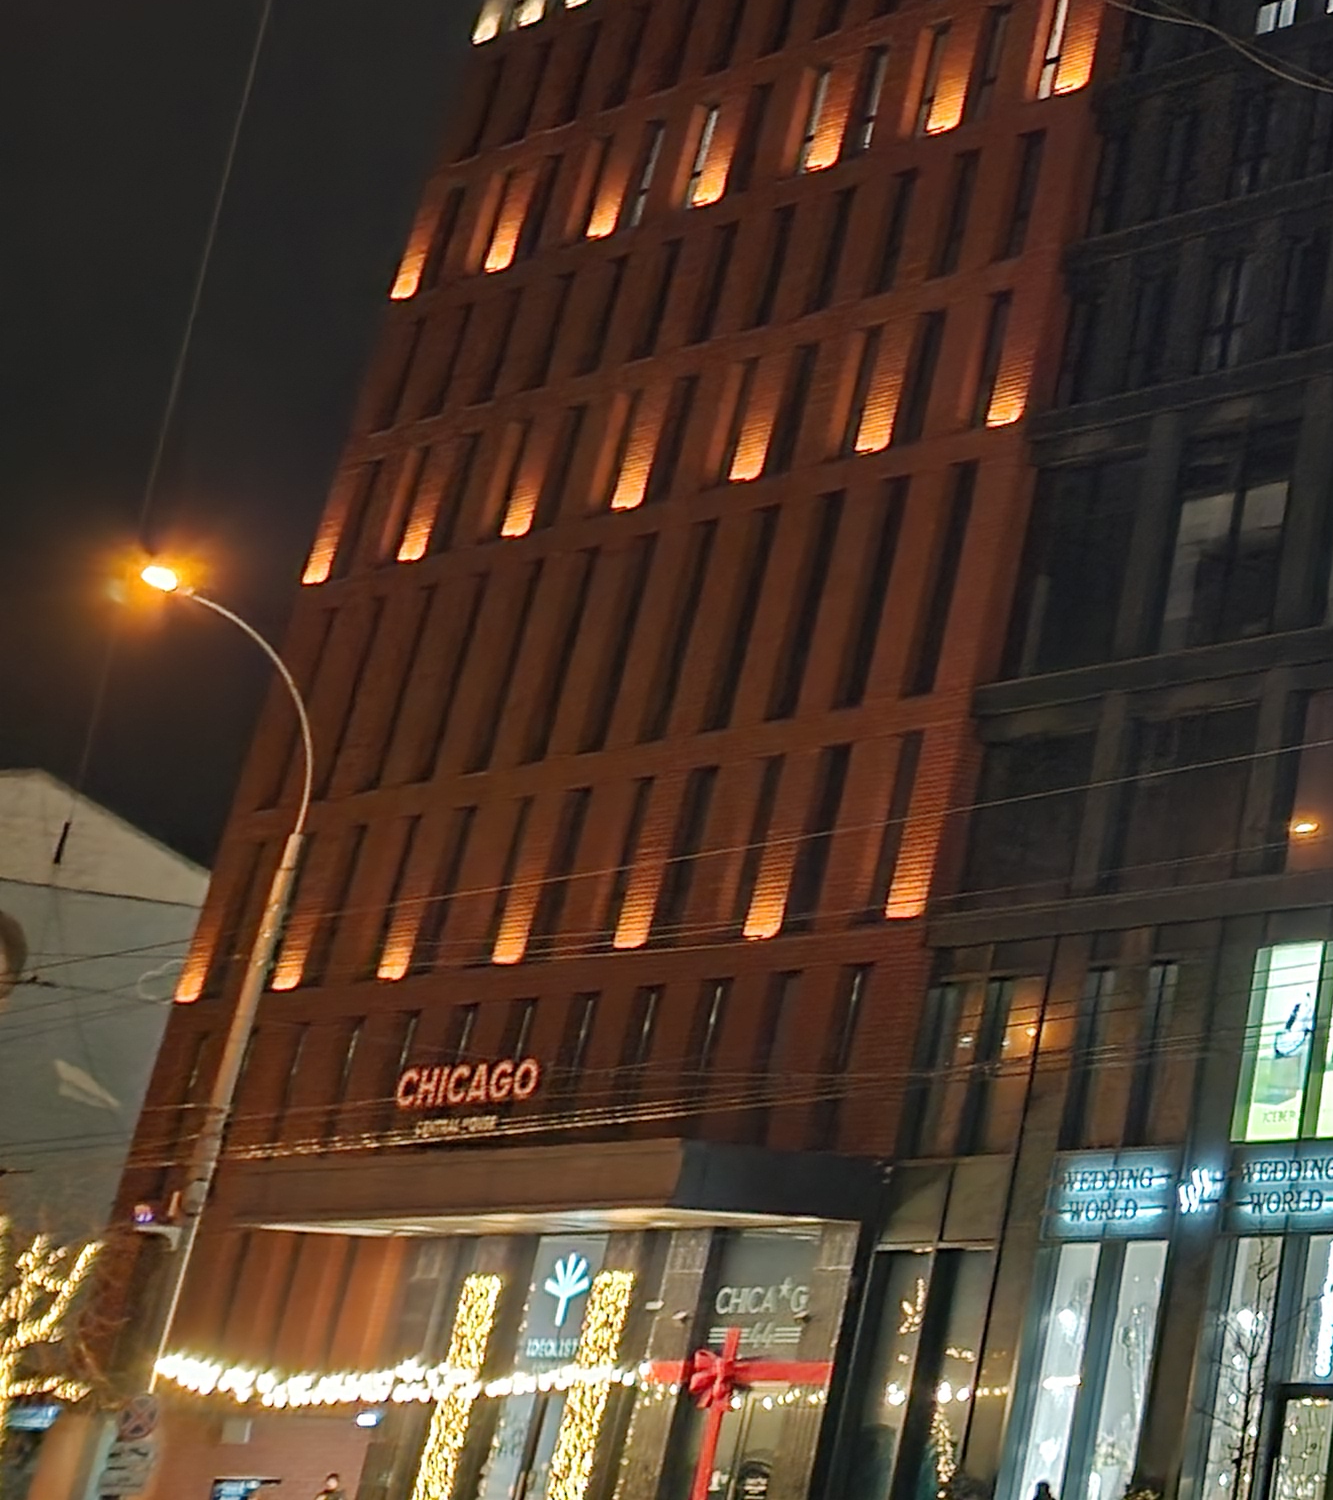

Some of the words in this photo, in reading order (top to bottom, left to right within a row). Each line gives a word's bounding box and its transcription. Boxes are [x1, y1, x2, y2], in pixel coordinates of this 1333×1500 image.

[396, 1057, 540, 1108] CHICAGO
[1062, 1166, 1154, 1193] WEDDING
[1070, 1198, 1139, 1222] WORLD
[1249, 1190, 1324, 1214] WORLD
